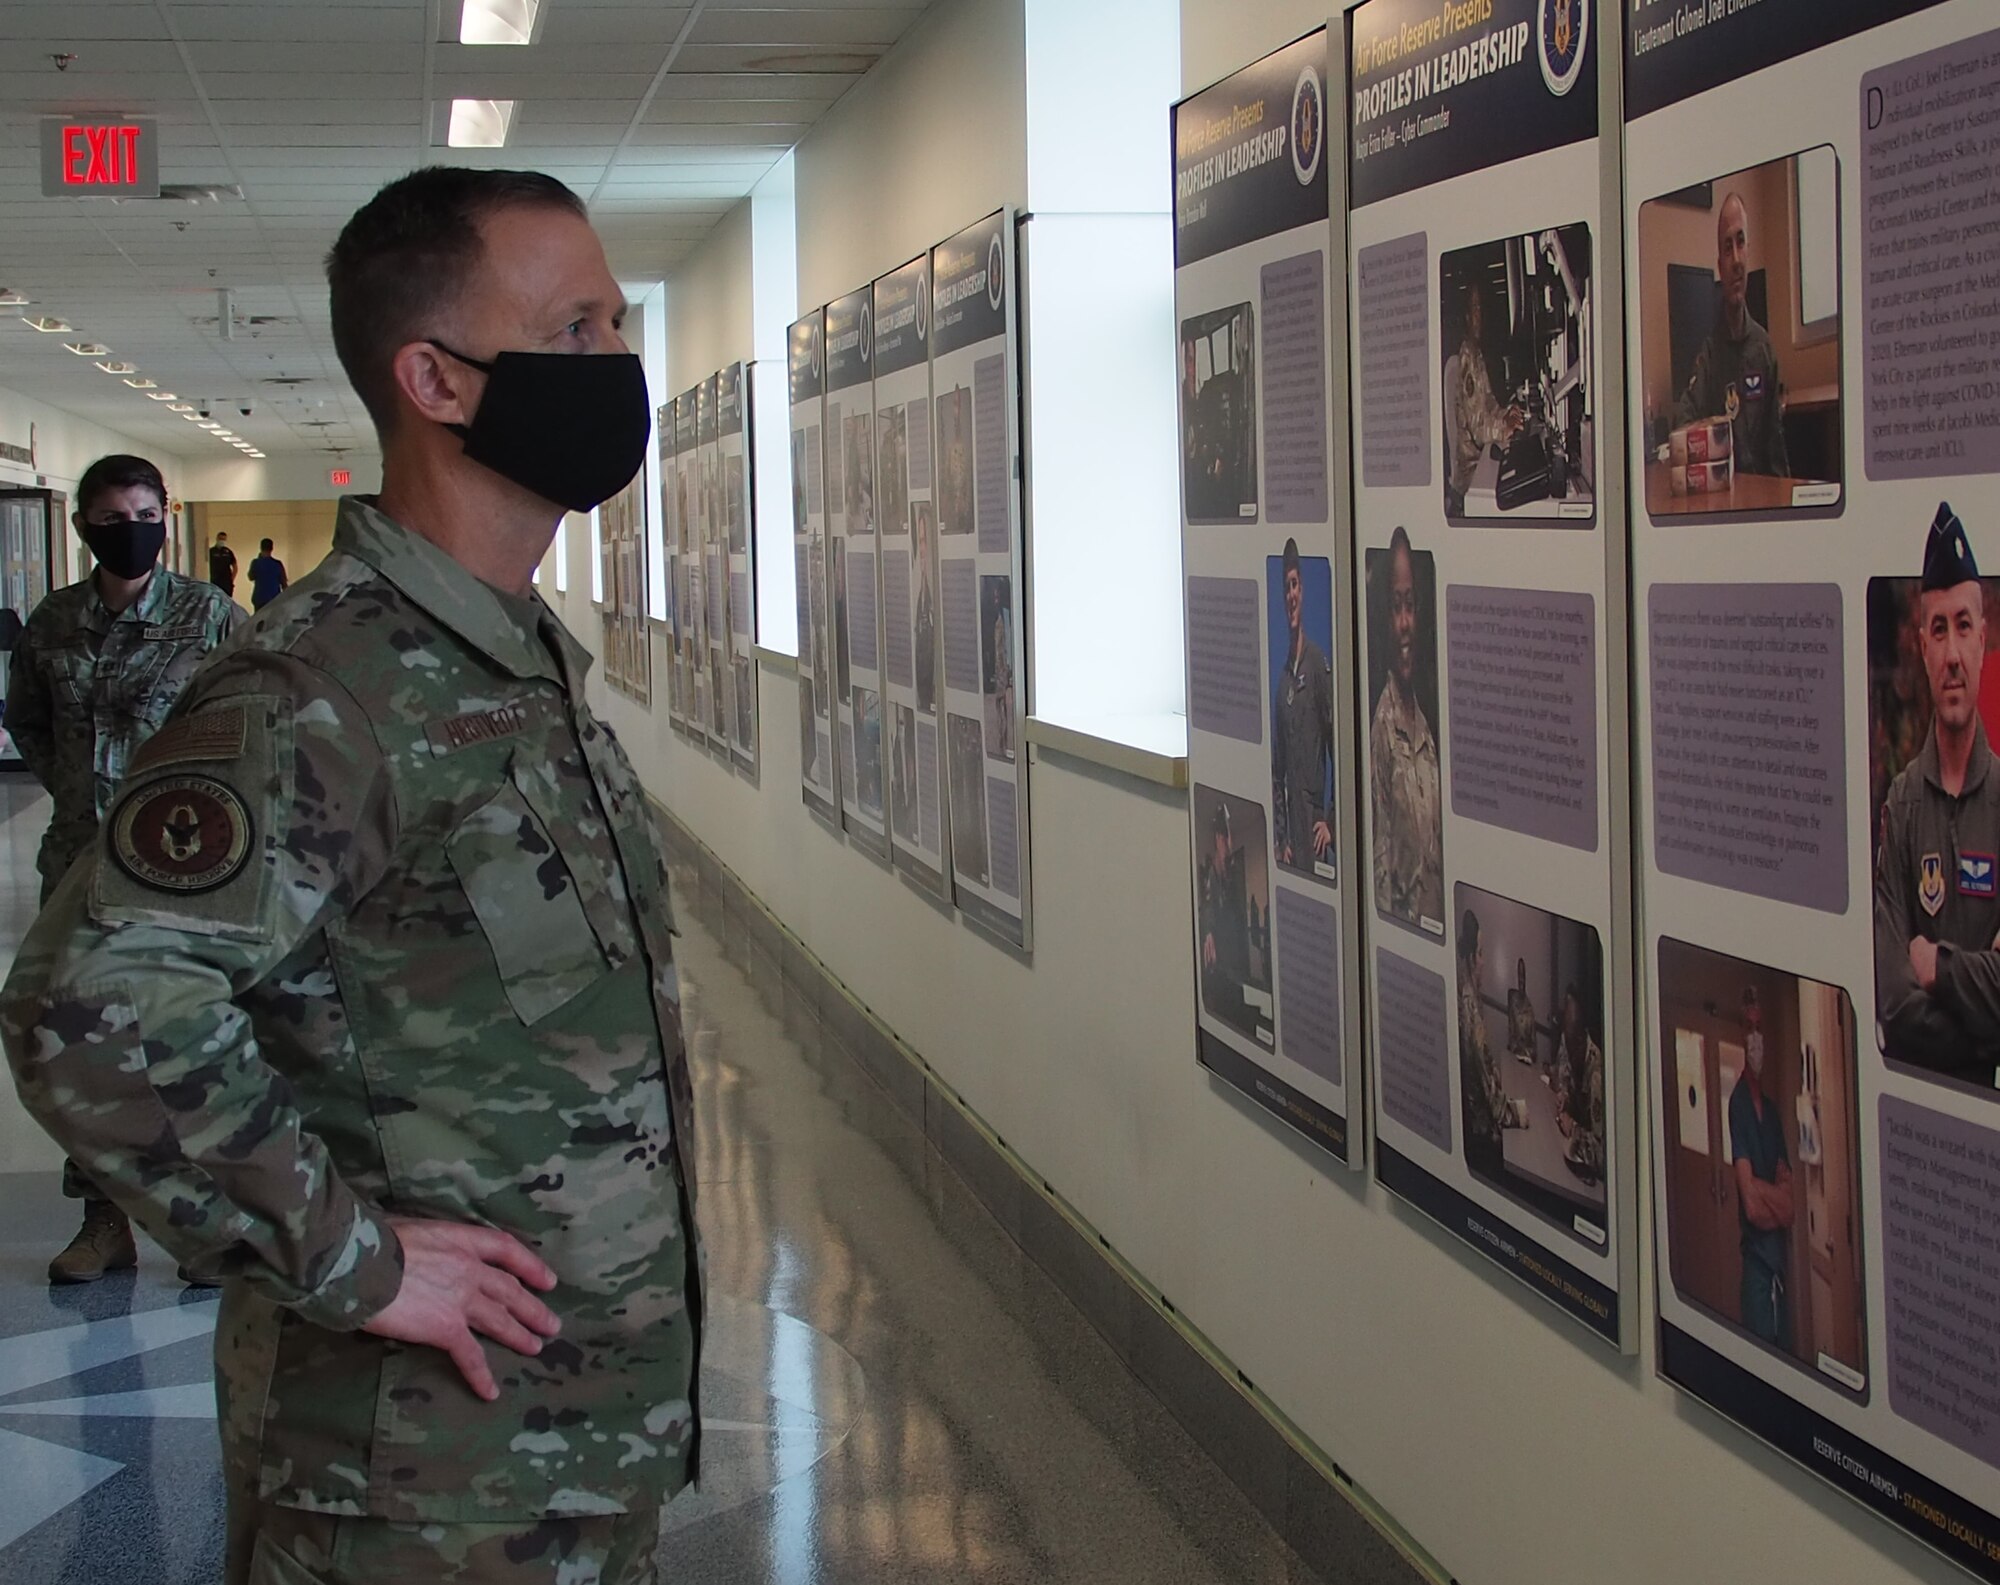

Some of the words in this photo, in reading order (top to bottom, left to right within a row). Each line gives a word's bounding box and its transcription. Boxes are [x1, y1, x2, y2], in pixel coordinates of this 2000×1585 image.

[1356, 45, 1370, 77] Air
[1372, 35, 1397, 69] Force
[1400, 22, 1440, 57] Reserve
[1443, 0, 1492, 38] Presents
[1635, 16, 1674, 56] Lieutenant
[1676, 0, 1706, 37] Colonel
[1707, 0, 1725, 24] Joel
[1356, 69, 1411, 125] PROFILES
[1415, 61, 1430, 101] IN
[1433, 21, 1528, 94] LEADERSHIP
[1188, 129, 1204, 155] Force
[1207, 116, 1231, 145] Reserve
[1232, 99, 1264, 133] Presents
[1417, 104, 1450, 137] Commander
[1911, 128, 1923, 144] the
[1926, 122, 1951, 140] Center
[62, 126, 141, 185] EXIT
[1177, 157, 1213, 200] PROFILES
[1214, 151, 1225, 183] IN
[1226, 125, 1286, 178] LEADERSHIP
[1898, 155, 1912, 175] and
[1914, 149, 1953, 168] Readiness
[1901, 180, 1935, 199] between
[1936, 172, 1949, 190] the
[1951, 164, 1992, 187] University
[1910, 201, 1941, 222] Medical
[1943, 198, 1969, 216] Center
[1971, 188, 1987, 210] and
[1897, 258, 1912, 279] and
[1913, 254, 1940, 277] critical
[1903, 290, 1920, 304] care
[1922, 285, 1953, 304] surgeon
[1964, 274, 1978, 293] the
[1906, 314, 1918, 329] the
[1920, 308, 1950, 326] Rockies
[1952, 306, 1961, 322] in
[1929, 328, 1978, 352] volunteered
[1979, 332, 1988, 345] to
[1943, 360, 1956, 377] the
[1932, 387, 1959, 410] against
[332, 471, 350, 485] EXIT
[189, 782, 231, 805] STATES
[1813, 1437, 1842, 1467] RESERVE
[1842, 1455, 1869, 1481] CITIZEN
[1869, 1472, 1898, 1501] AIRMEN
[1903, 1492, 1946, 1529] STATIONED
